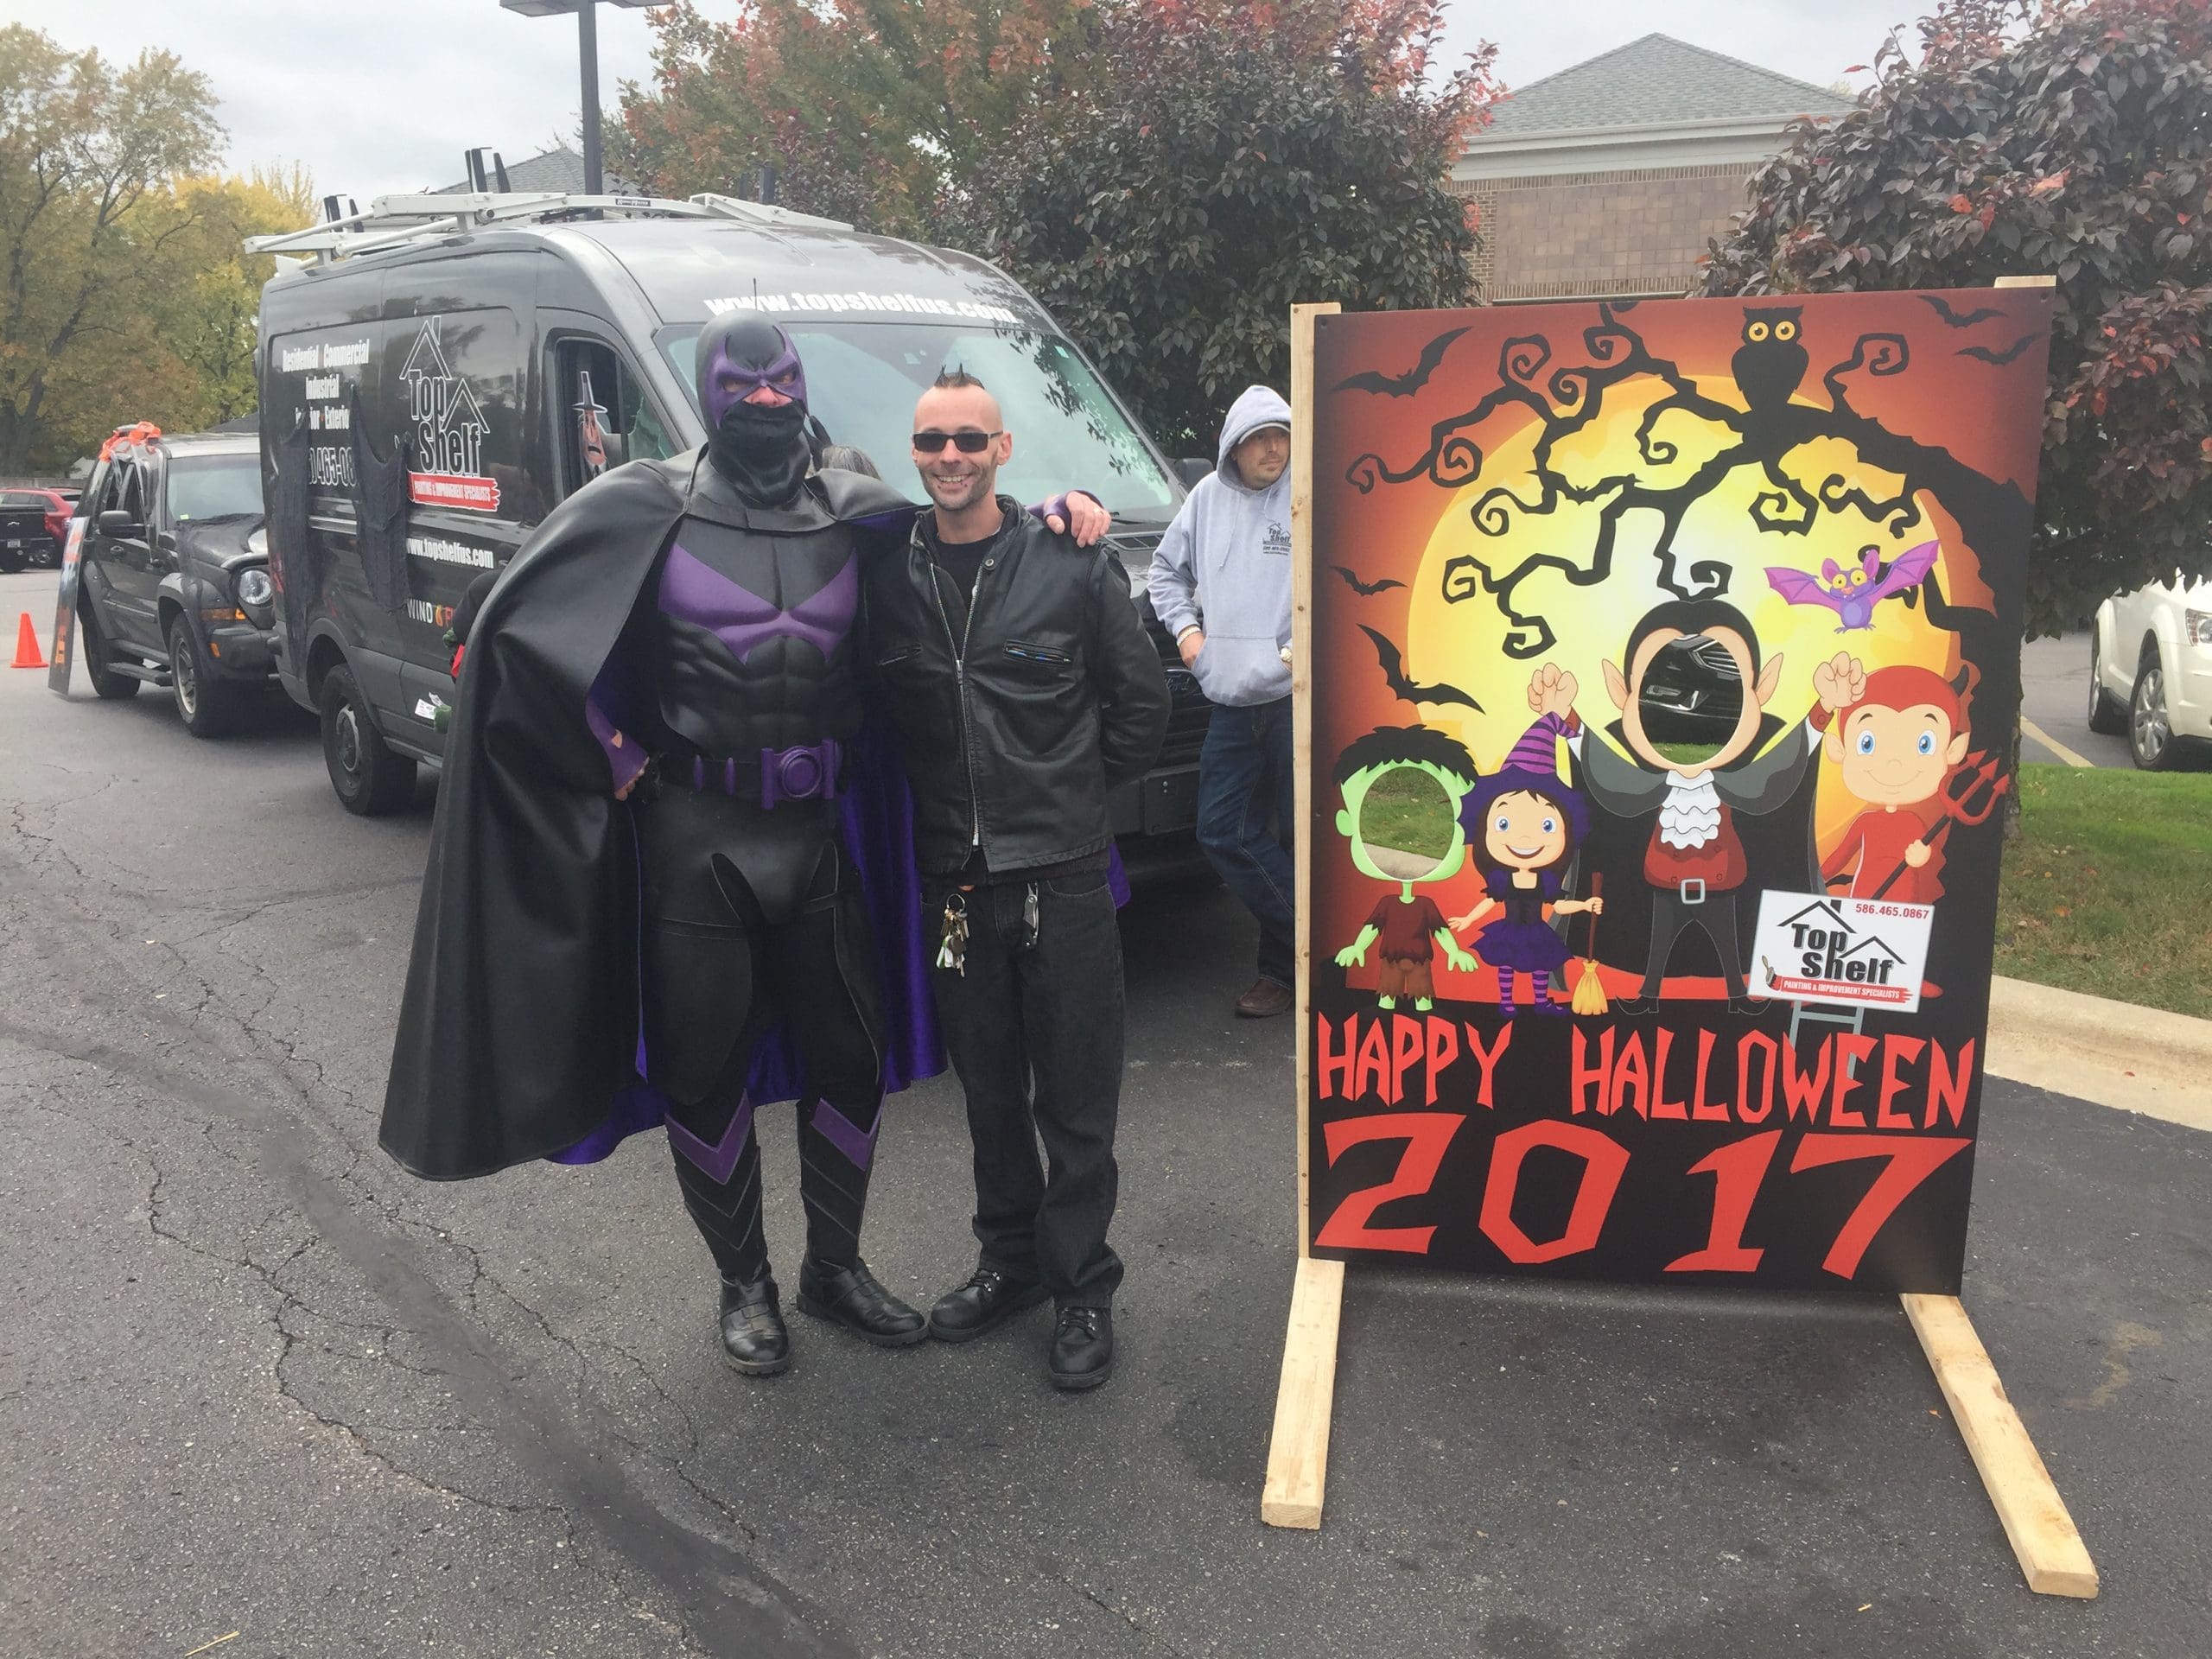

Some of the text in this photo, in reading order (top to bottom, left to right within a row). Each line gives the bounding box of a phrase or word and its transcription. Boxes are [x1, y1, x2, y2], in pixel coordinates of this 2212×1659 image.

[703, 291, 1019, 324] www.topshelfus.com
[283, 339, 370, 372] Residential Commercial
[306, 373, 340, 399] Industrial
[409, 369, 447, 422] Top
[325, 404, 351, 429] Exterio
[418, 421, 481, 477] Shelf
[406, 598, 433, 624] WIND
[1856, 903, 1929, 919] 586.465.0867
[1791, 923, 1848, 952] Top
[1801, 952, 1894, 984] Shelf
[1783, 980, 1812, 991] PAINTING
[1818, 983, 1861, 995] IMPROVEMENT
[1861, 987, 1900, 999] SPECIALISTS
[1316, 1010, 1975, 1129] HAPPY HALLOWEEN
[1314, 1112, 1974, 1281] 2017
